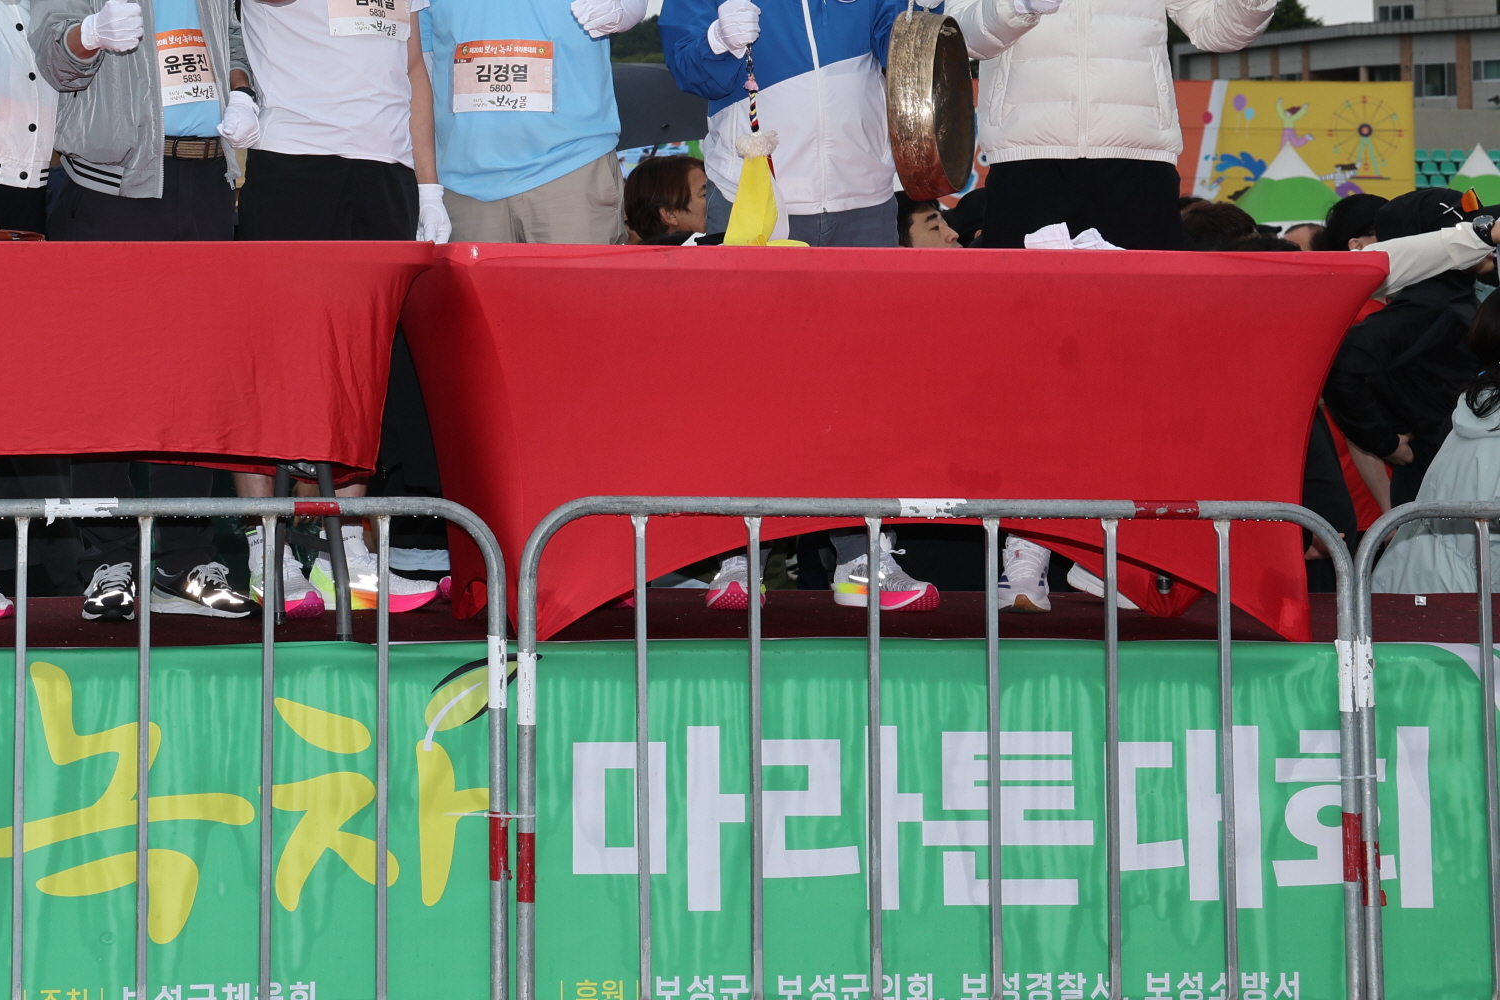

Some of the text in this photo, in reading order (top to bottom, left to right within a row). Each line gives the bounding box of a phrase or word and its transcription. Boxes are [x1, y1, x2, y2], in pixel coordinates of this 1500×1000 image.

[369, 8, 386, 18] 5830
[484, 44, 498, 54] 보성
[499, 44, 513, 54] 녹차
[164, 53, 209, 75] 윤동진
[183, 74, 202, 83] 5833
[475, 64, 528, 82] 김경열
[489, 84, 512, 92] 5800
[496, 94, 528, 109] 보성몰
[573, 725, 1433, 911] 마라톤대회
